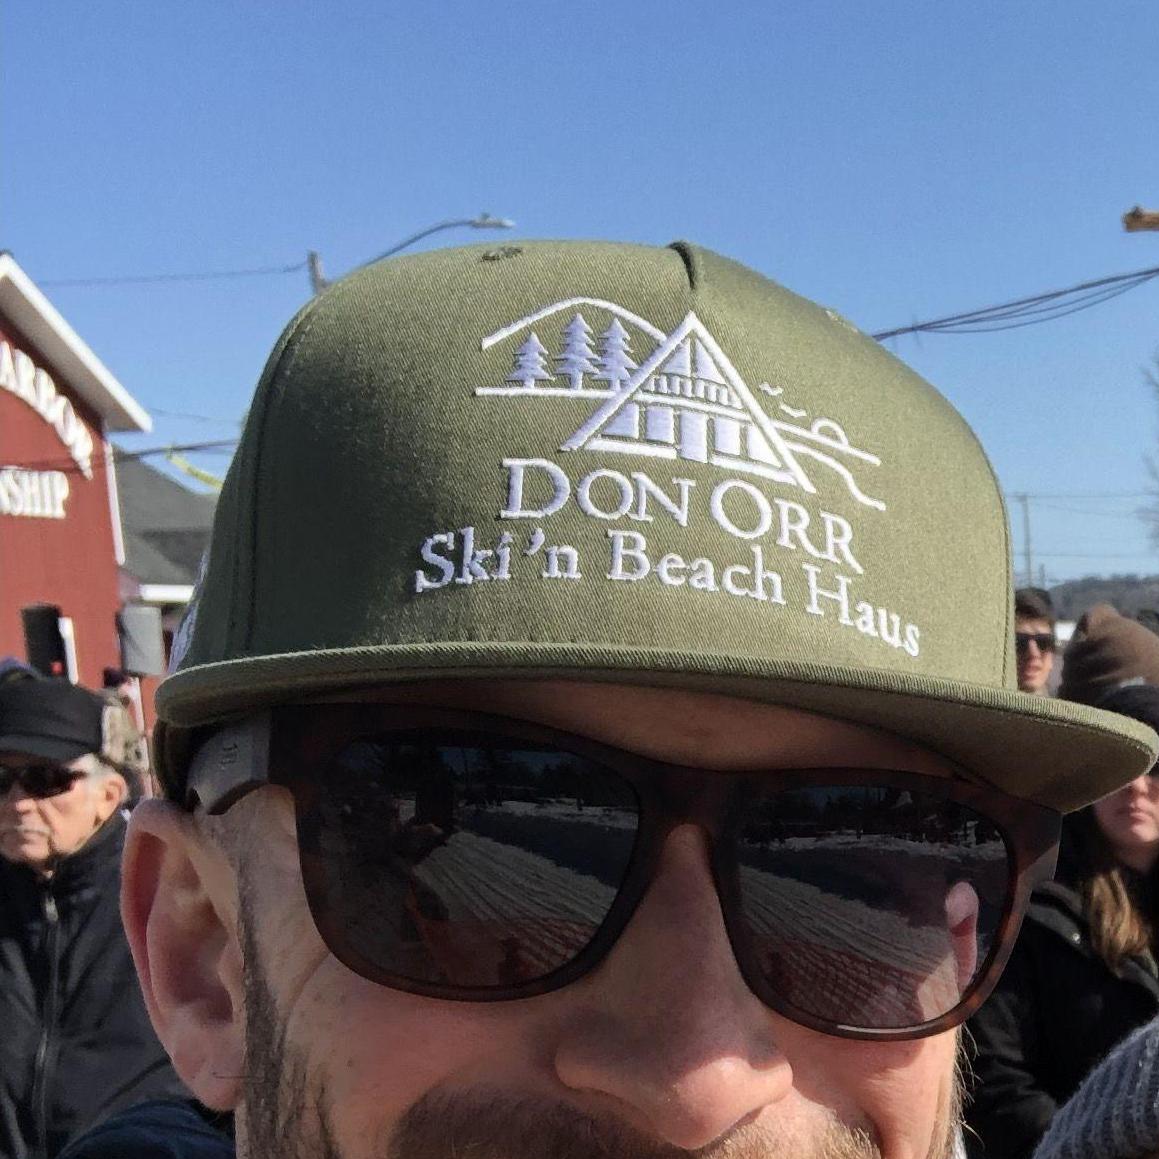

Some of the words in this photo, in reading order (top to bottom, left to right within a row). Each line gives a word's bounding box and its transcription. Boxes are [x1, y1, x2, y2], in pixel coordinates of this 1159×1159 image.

[500, 458, 696, 527] DON
[709, 479, 864, 575] ORR
[415, 527, 583, 593] Ski'n
[606, 530, 787, 605] Beach
[801, 562, 921, 659] Haus
